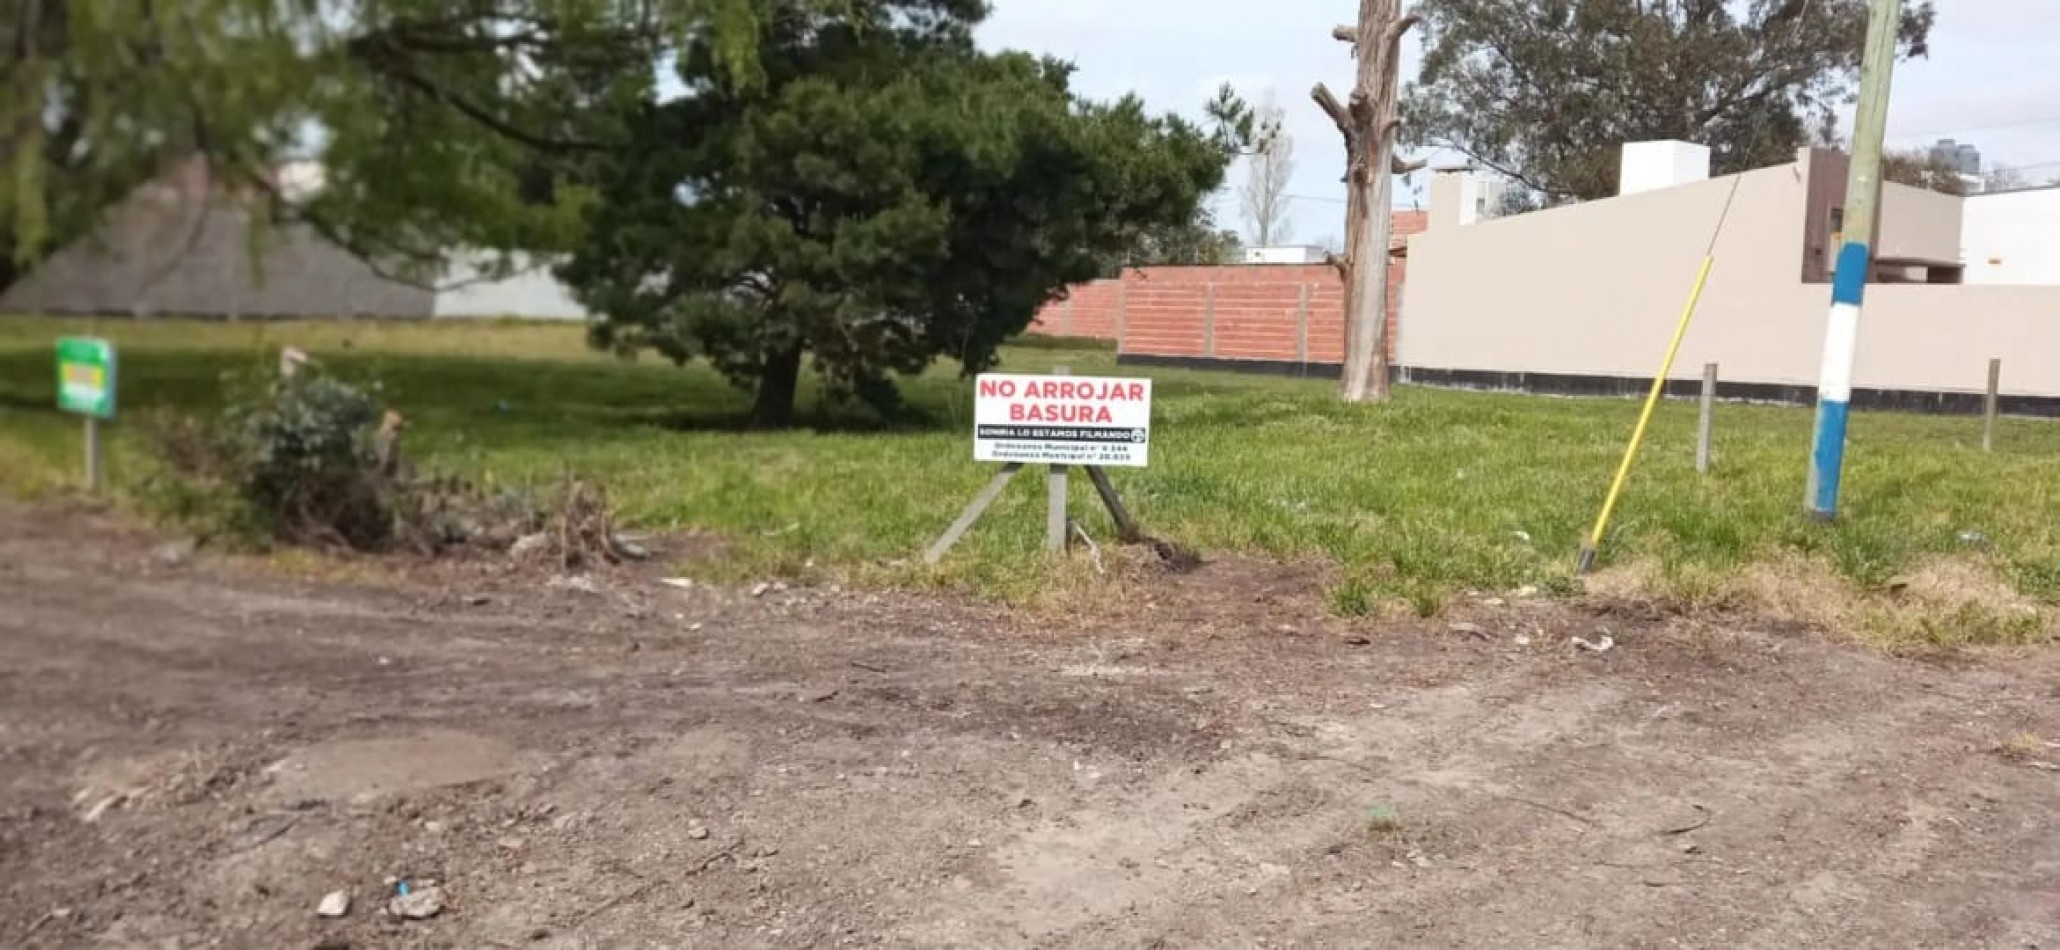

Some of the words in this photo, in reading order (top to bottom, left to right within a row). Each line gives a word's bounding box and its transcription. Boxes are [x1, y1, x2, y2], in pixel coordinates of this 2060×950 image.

[980, 380, 1015, 397] NO
[1024, 381, 1143, 401] ARROJAR
[1010, 403, 1112, 423] BASURA
[1017, 428, 1029, 437] LO
[1032, 428, 1078, 438] ESTAMOS
[1079, 429, 1130, 440] FILMANDO
